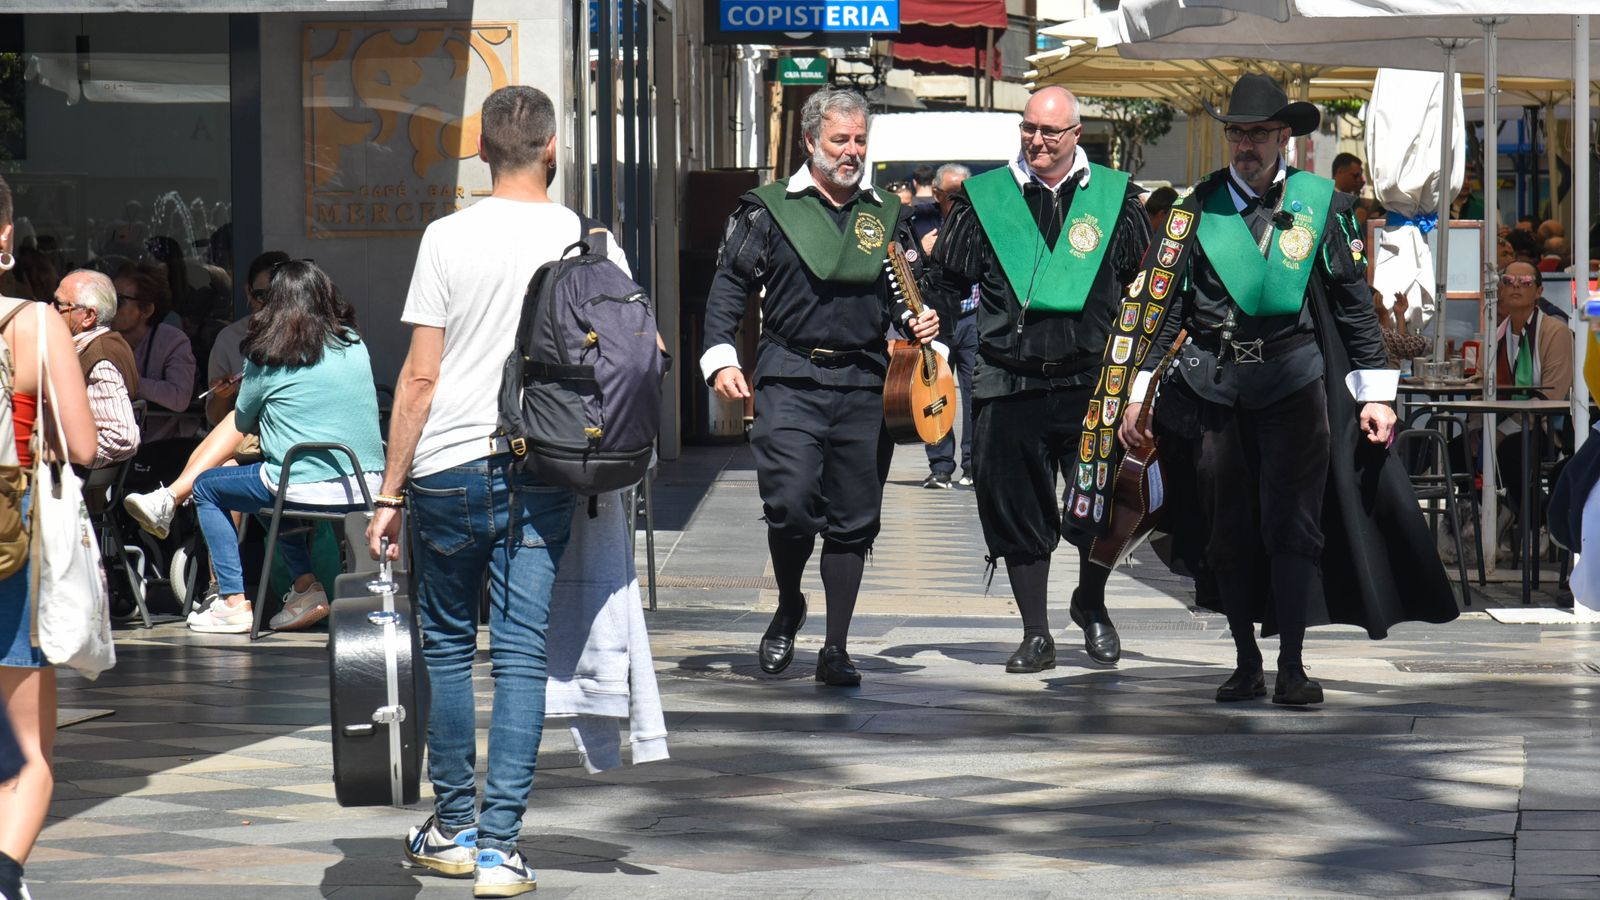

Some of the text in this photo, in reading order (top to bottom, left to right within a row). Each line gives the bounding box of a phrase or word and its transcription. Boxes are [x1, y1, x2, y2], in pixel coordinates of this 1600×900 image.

[727, 5, 890, 27] COPISTERIA
[359, 181, 465, 199] CAFÉ BAR
